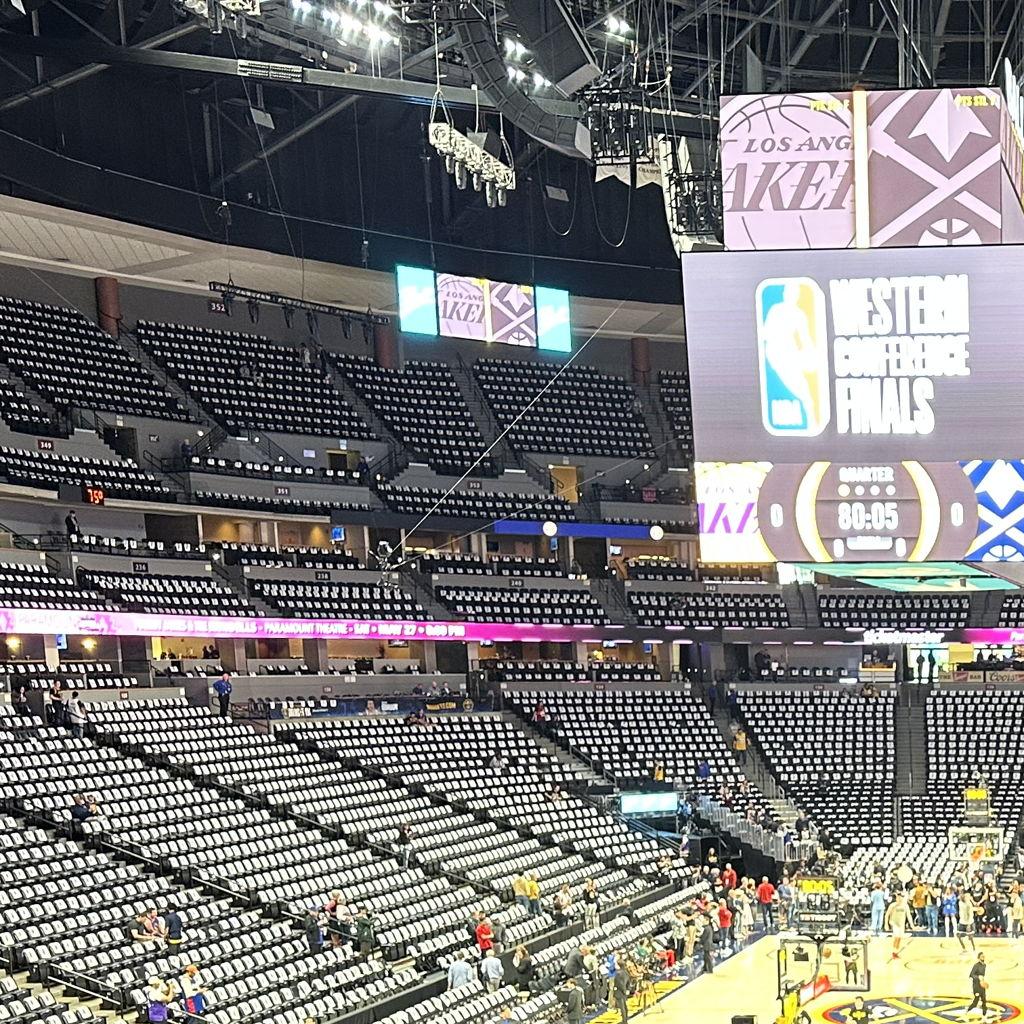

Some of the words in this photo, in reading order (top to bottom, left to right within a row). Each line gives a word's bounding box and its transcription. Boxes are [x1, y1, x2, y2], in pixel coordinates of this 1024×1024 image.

[744, 136, 792, 153] LOS
[211, 302, 226, 312] 352
[829, 274, 970, 336] WESTERN
[834, 335, 971, 377] CONFERENCE
[835, 377, 935, 435] FINALS
[839, 467, 895, 483] QUARTER
[837, 502, 899, 530] 80:05
[265, 622, 314, 634] PARAMOUNT
[315, 623, 348, 635] THEATRE
[448, 625, 465, 636] PM
[863, 629, 945, 645] ticketmaster
[989, 671, 1015, 681] Coors
